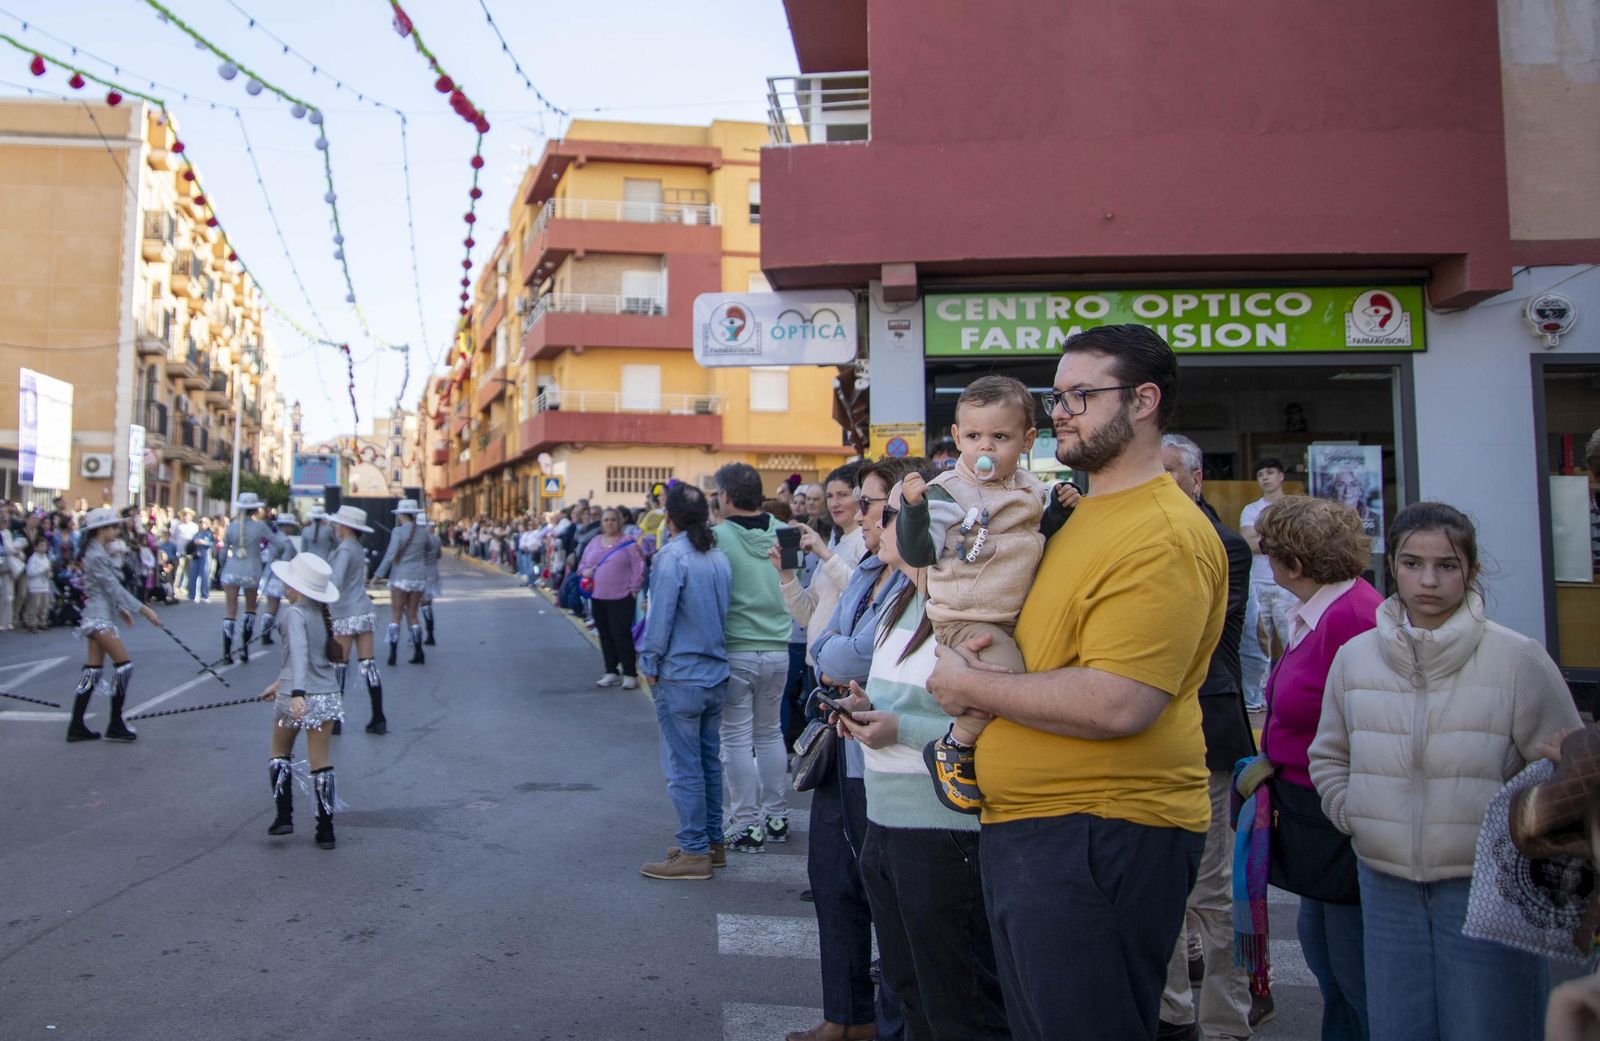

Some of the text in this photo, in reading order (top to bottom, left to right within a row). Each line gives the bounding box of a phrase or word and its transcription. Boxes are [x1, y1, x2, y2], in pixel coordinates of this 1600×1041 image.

[936, 293, 1311, 320] CENTRO OPTICO
[770, 321, 846, 339] ÓPTICA
[960, 323, 1286, 349] FARMISION
